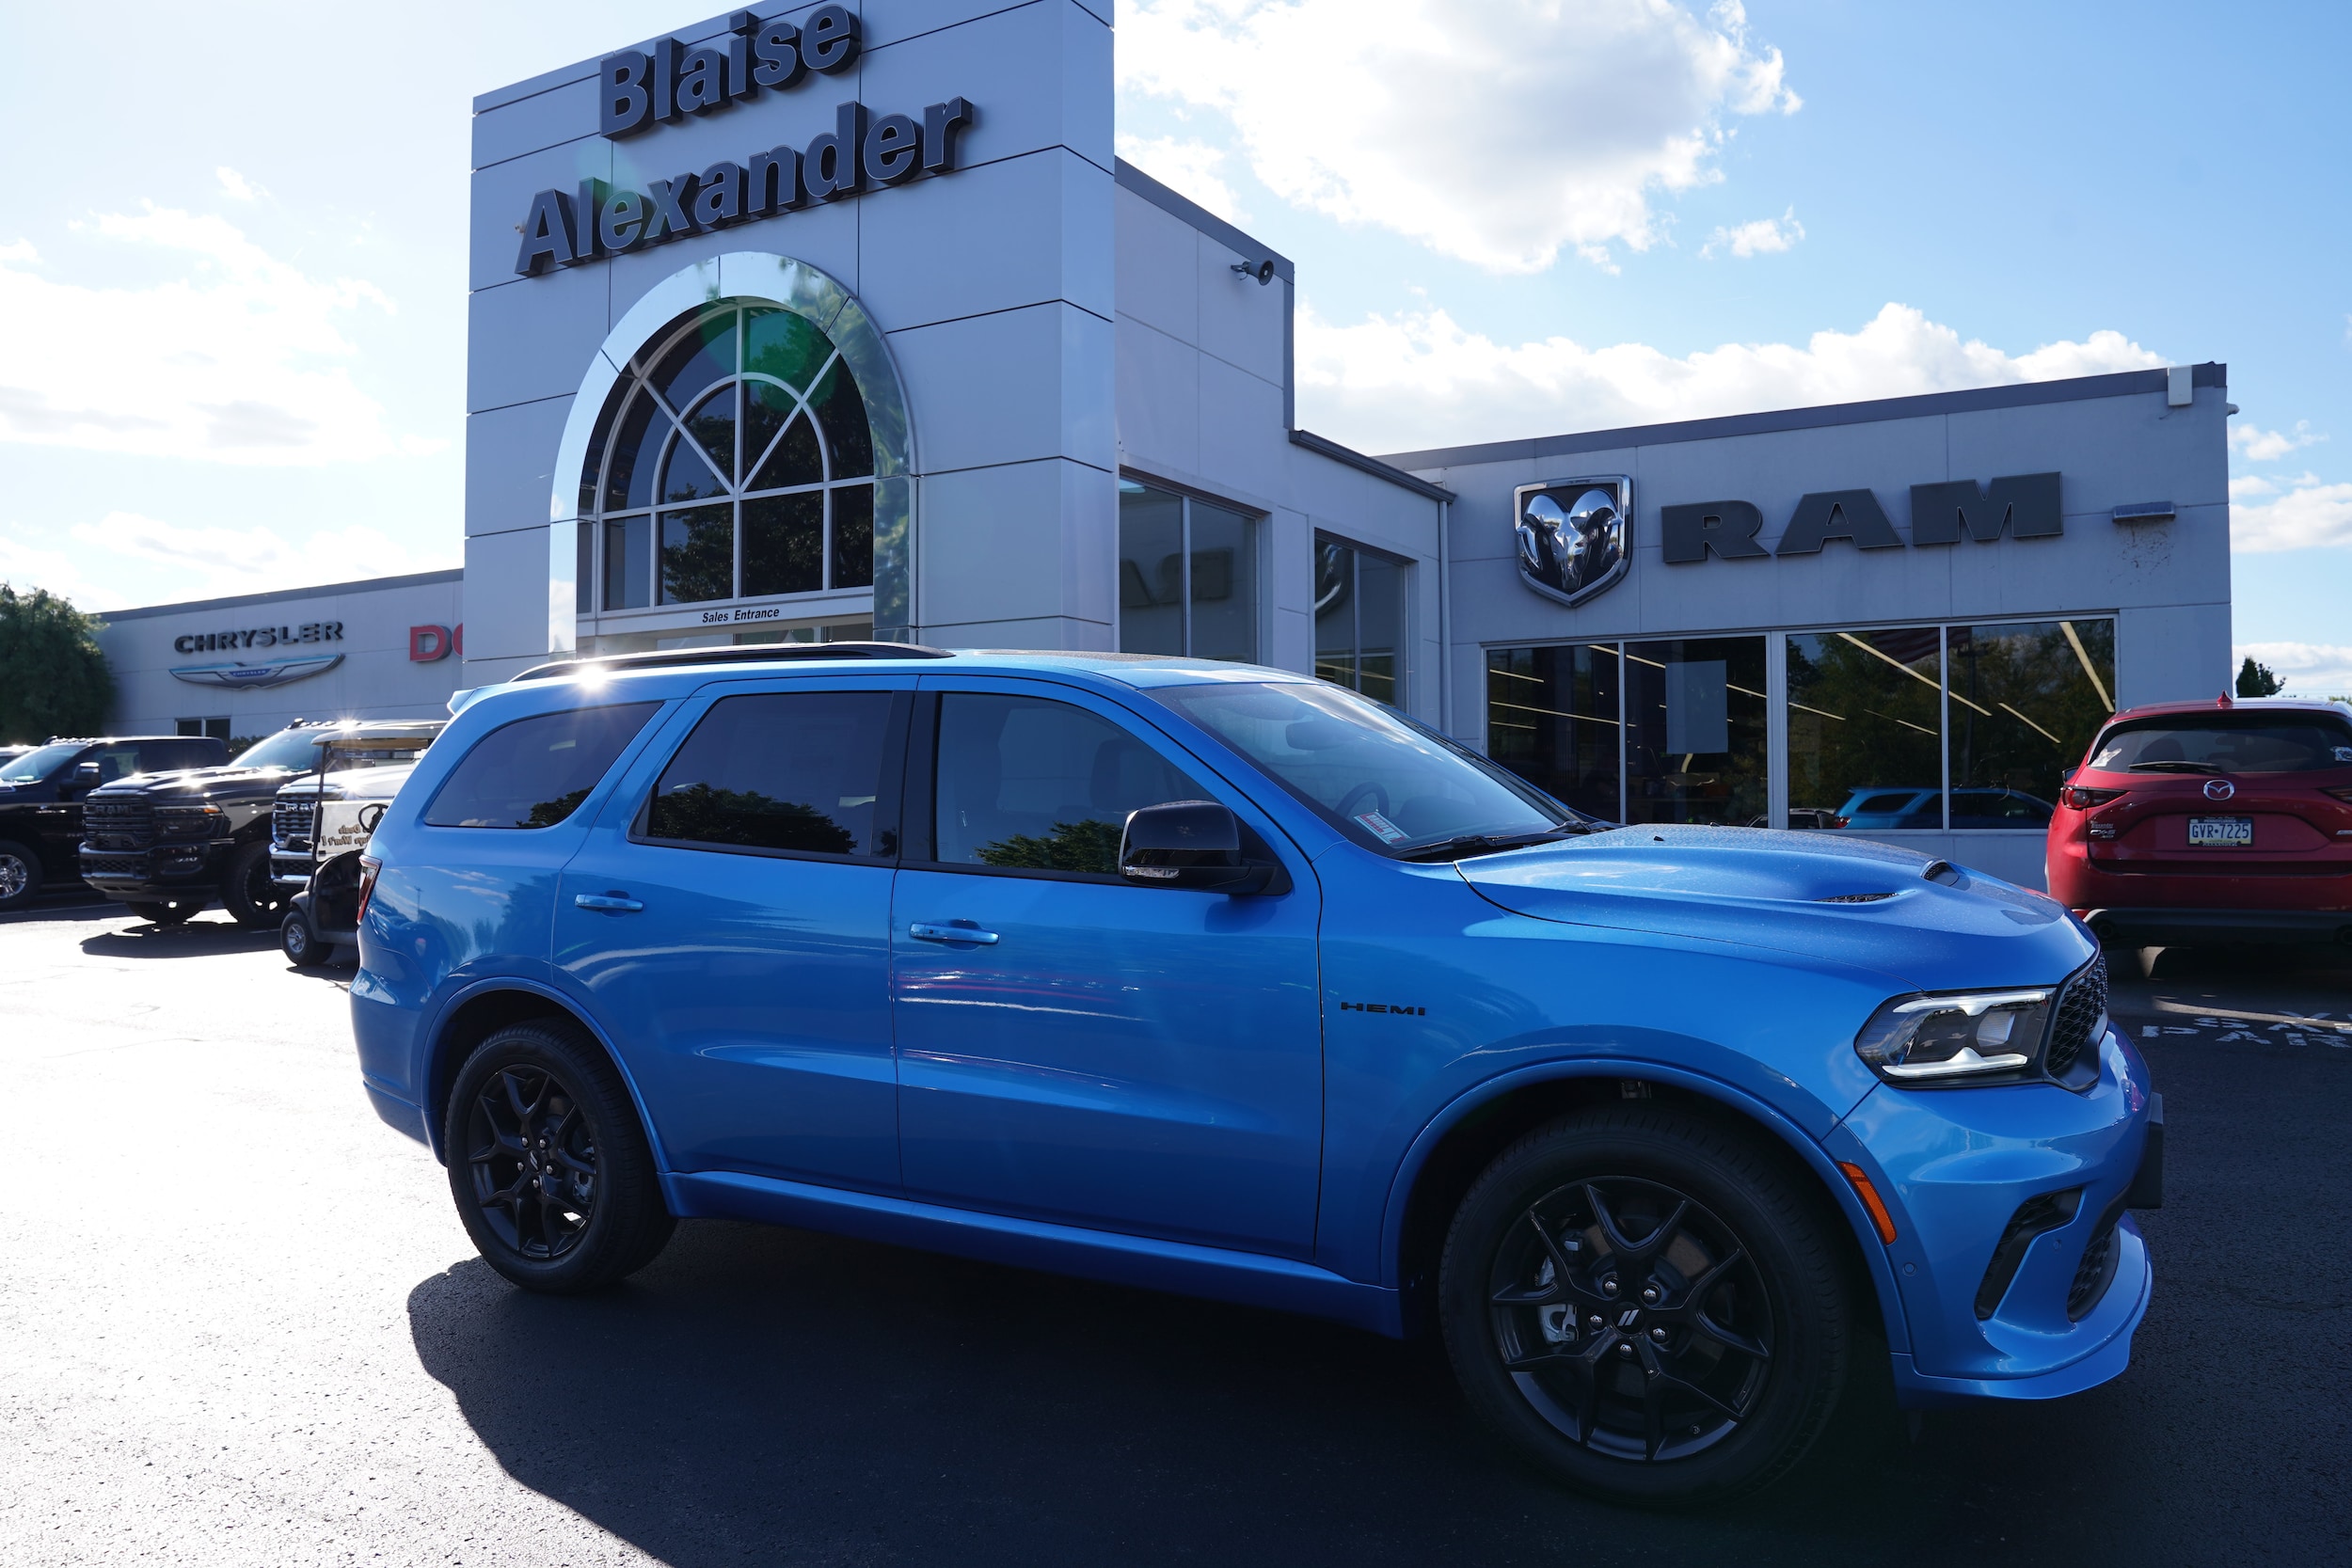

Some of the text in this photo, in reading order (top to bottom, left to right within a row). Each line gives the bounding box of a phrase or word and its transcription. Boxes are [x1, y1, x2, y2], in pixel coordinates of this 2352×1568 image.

[600, 4, 861, 140] Blaise
[515, 96, 973, 277] Alexander
[1661, 471, 2064, 563] RAM
[702, 608, 780, 624] Sales Entrance
[174, 621, 344, 654] CHRYSLER
[95, 804, 130, 815] RAM
[1341, 1002, 1426, 1016] HEMI
